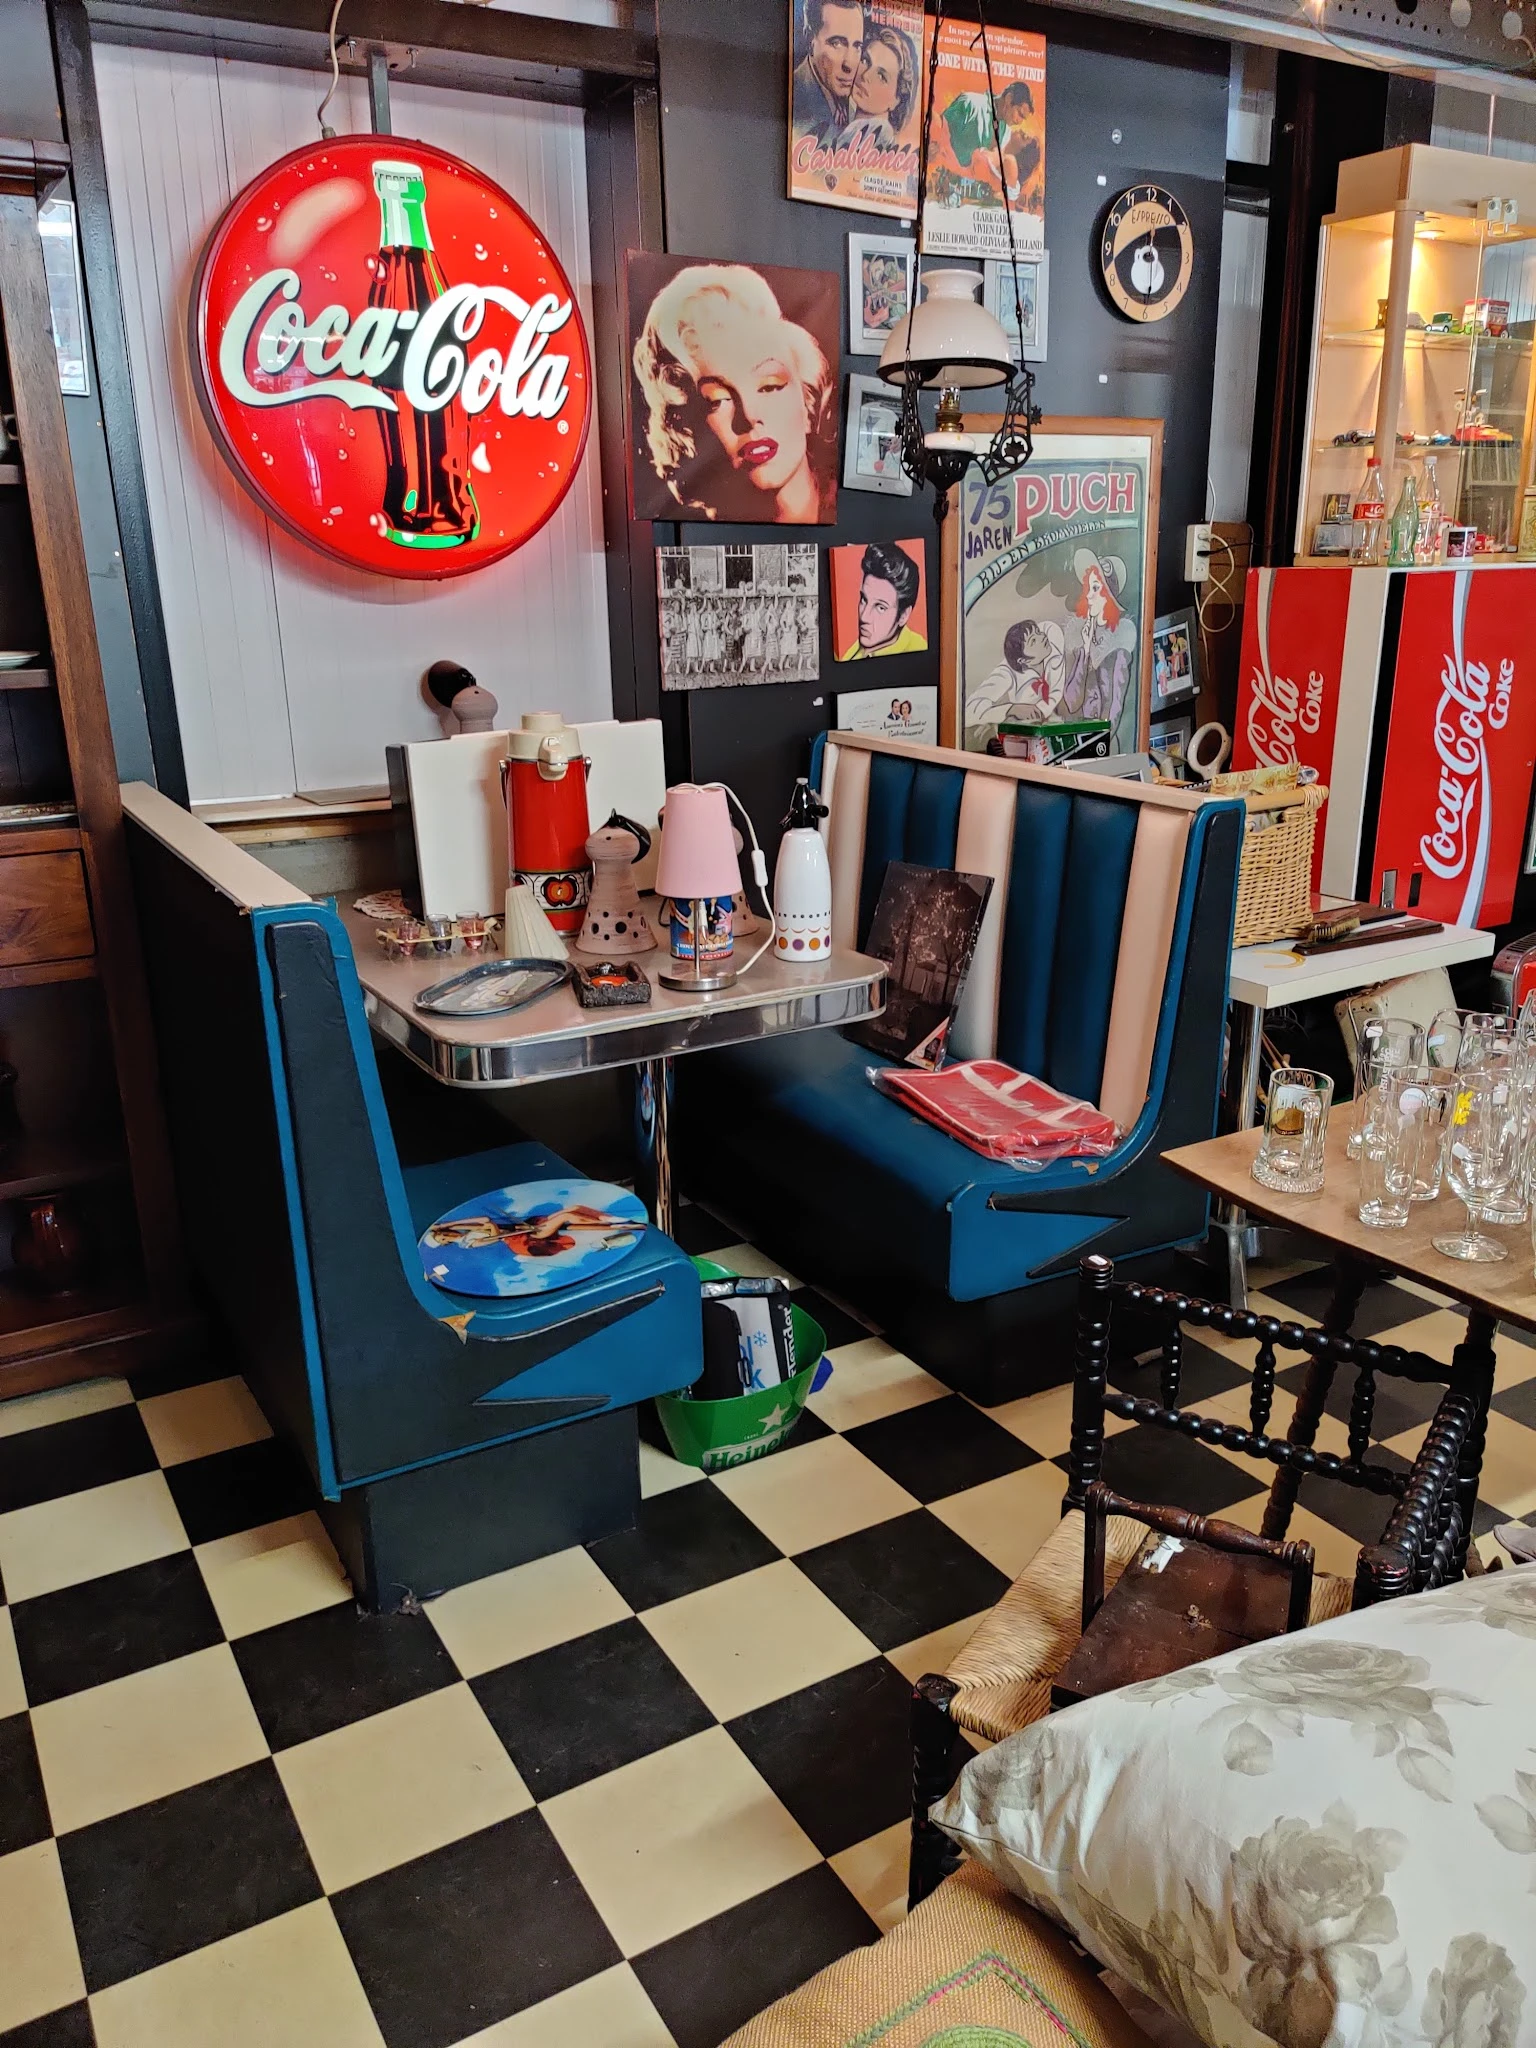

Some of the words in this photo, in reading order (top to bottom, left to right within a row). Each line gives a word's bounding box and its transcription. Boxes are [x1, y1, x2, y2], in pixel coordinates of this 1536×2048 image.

[930, 31, 943, 42] Te
[944, 36, 962, 45] most
[1003, 45, 1027, 56] picture
[937, 51, 961, 70] ONE
[991, 60, 1015, 78] THE
[1015, 64, 1046, 83] WIND
[792, 130, 919, 175] Casablanca
[1126, 193, 1135, 207] 11
[1146, 188, 1157, 202] 12
[1167, 198, 1173, 212] 1
[973, 211, 994, 223] CLARK
[1110, 212, 1121, 226] 10
[927, 231, 951, 244] LESLIE
[951, 233, 979, 246] HOWARD
[980, 235, 1002, 248] OLIVIA
[973, 223, 995, 235] VIVIEN
[1105, 241, 1112, 256] 9
[1184, 252, 1190, 265] 3
[220, 268, 573, 420] Coca-Cola
[967, 481, 1011, 526] 75
[1013, 471, 1136, 541] PUCH
[965, 523, 1013, 560] JAREN
[1298, 670, 1325, 734] Coke
[1487, 657, 1515, 730] Coke
[1420, 653, 1491, 880] Coca-Cola
